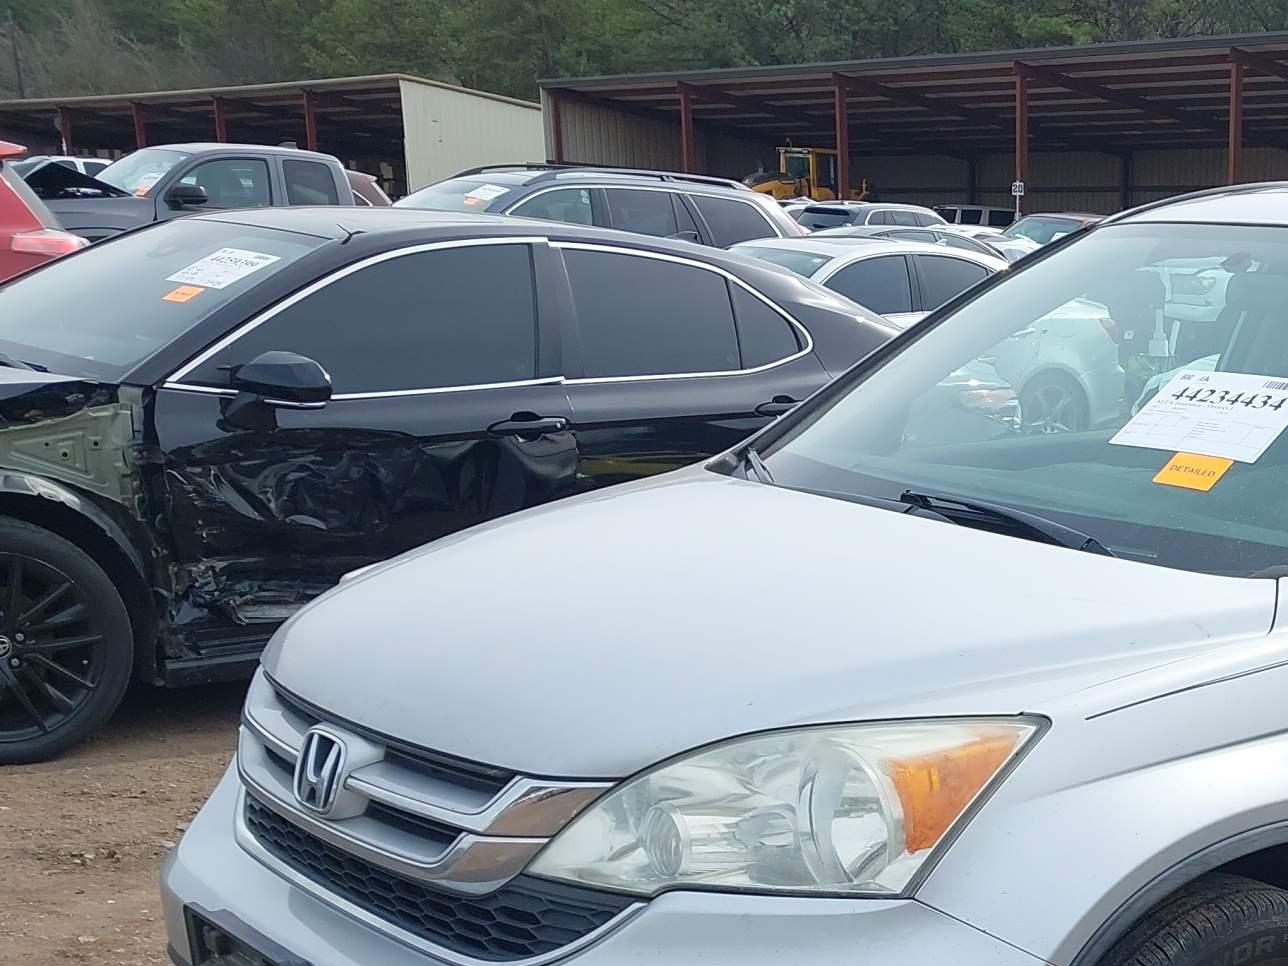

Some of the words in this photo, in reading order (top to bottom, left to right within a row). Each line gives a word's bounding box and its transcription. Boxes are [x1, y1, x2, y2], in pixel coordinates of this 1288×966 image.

[1012, 184, 1023, 193] 20
[1171, 386, 1288, 412] 44234434
[1169, 464, 1216, 477] DETAILED
